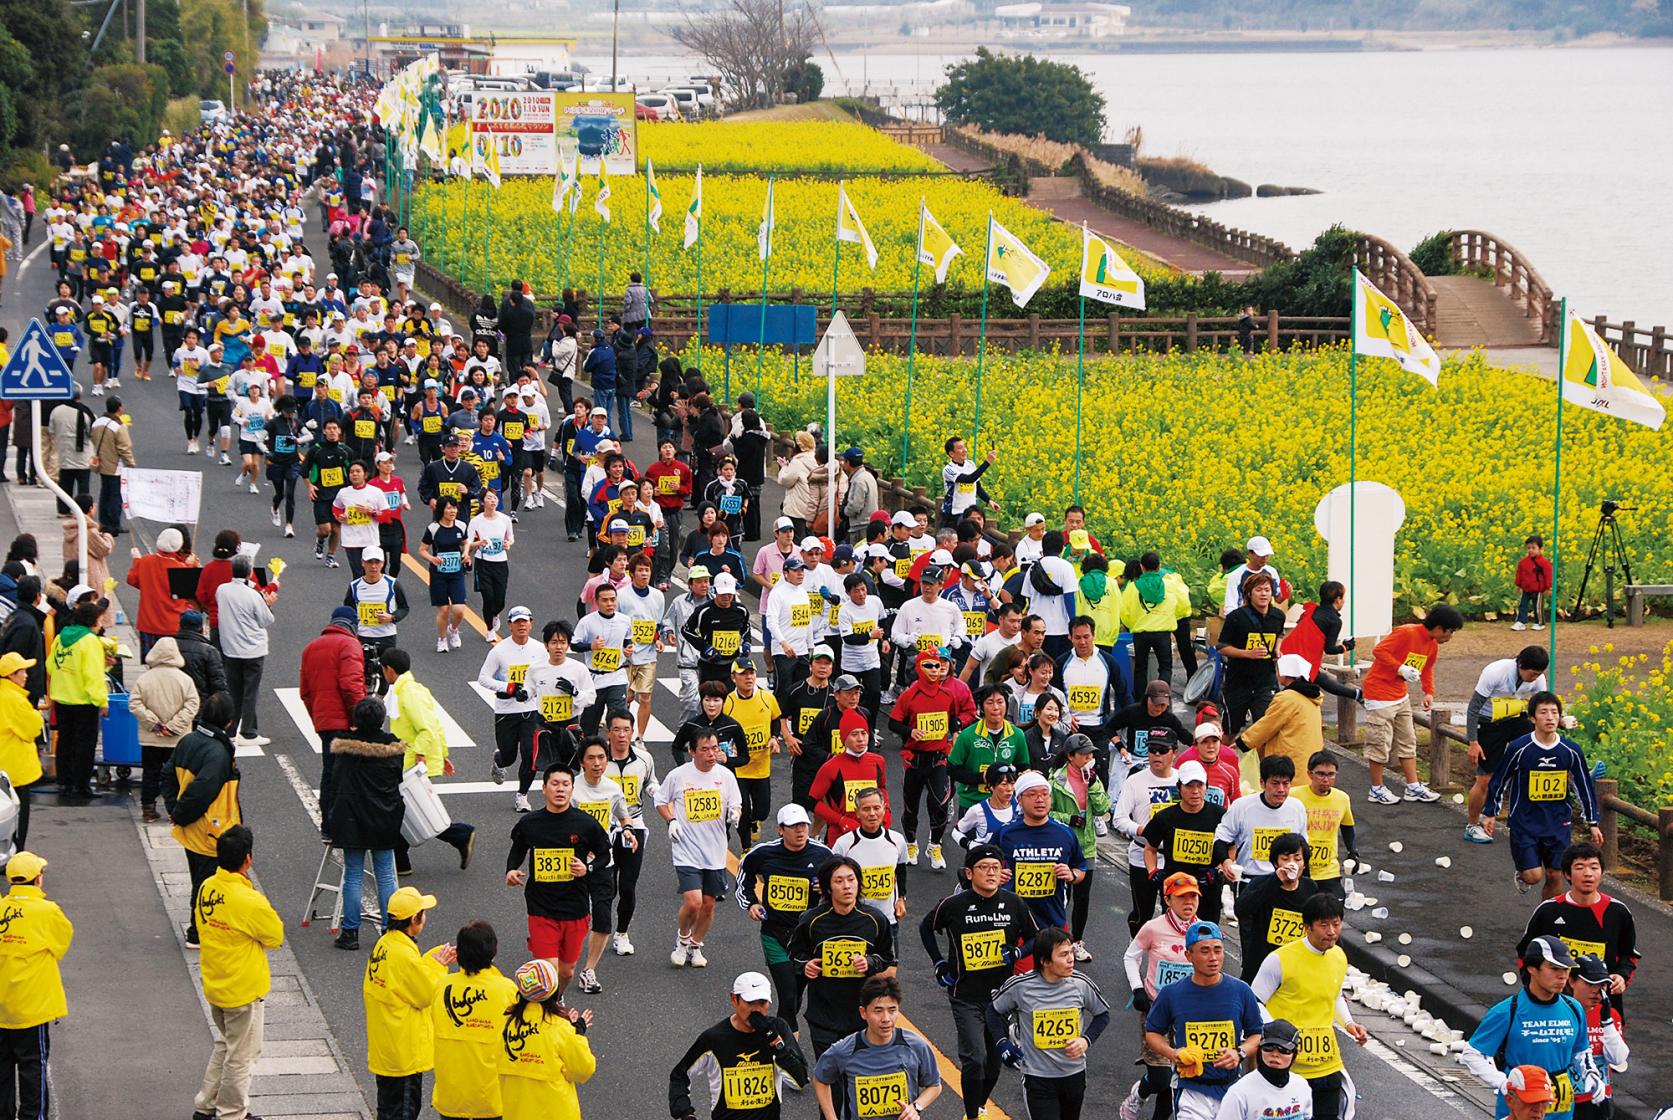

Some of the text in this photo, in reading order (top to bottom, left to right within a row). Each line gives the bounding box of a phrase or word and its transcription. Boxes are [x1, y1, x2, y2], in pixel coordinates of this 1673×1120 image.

[476, 97, 522, 120] 2010
[538, 105, 550, 113] SUN
[1591, 398, 1610, 409] JAL
[482, 450, 492, 459] 10
[324, 473, 339, 481] 1921
[792, 609, 809, 621] 8544
[964, 617, 983, 628] 069
[633, 626, 654, 637] 3529
[714, 637, 736, 648] 12166
[593, 652, 618, 664] 4764
[1070, 692, 1097, 704] 4592
[543, 701, 567, 714] 2121
[920, 719, 945, 732] 11905
[1536, 778, 1560, 792] 102
[688, 796, 718, 812] 12583
[1176, 837, 1209, 855] 10250
[1012, 848, 1062, 858] ATHLETA
[536, 857, 567, 872] 3831
[865, 873, 891, 890] 3545
[1018, 872, 1051, 887] 6287
[770, 884, 804, 901] 8509
[965, 914, 987, 924] Run
[993, 912, 1011, 921] Live
[1271, 917, 1305, 938] 3729
[965, 940, 1000, 959] 9877
[444, 984, 488, 1027] Ibusuki
[1036, 1018, 1074, 1037] 4265
[1522, 1020, 1546, 1028] TEAM
[1189, 1032, 1229, 1050] 9278
[729, 1076, 768, 1097] 11826
[859, 1084, 902, 1106] 8079
